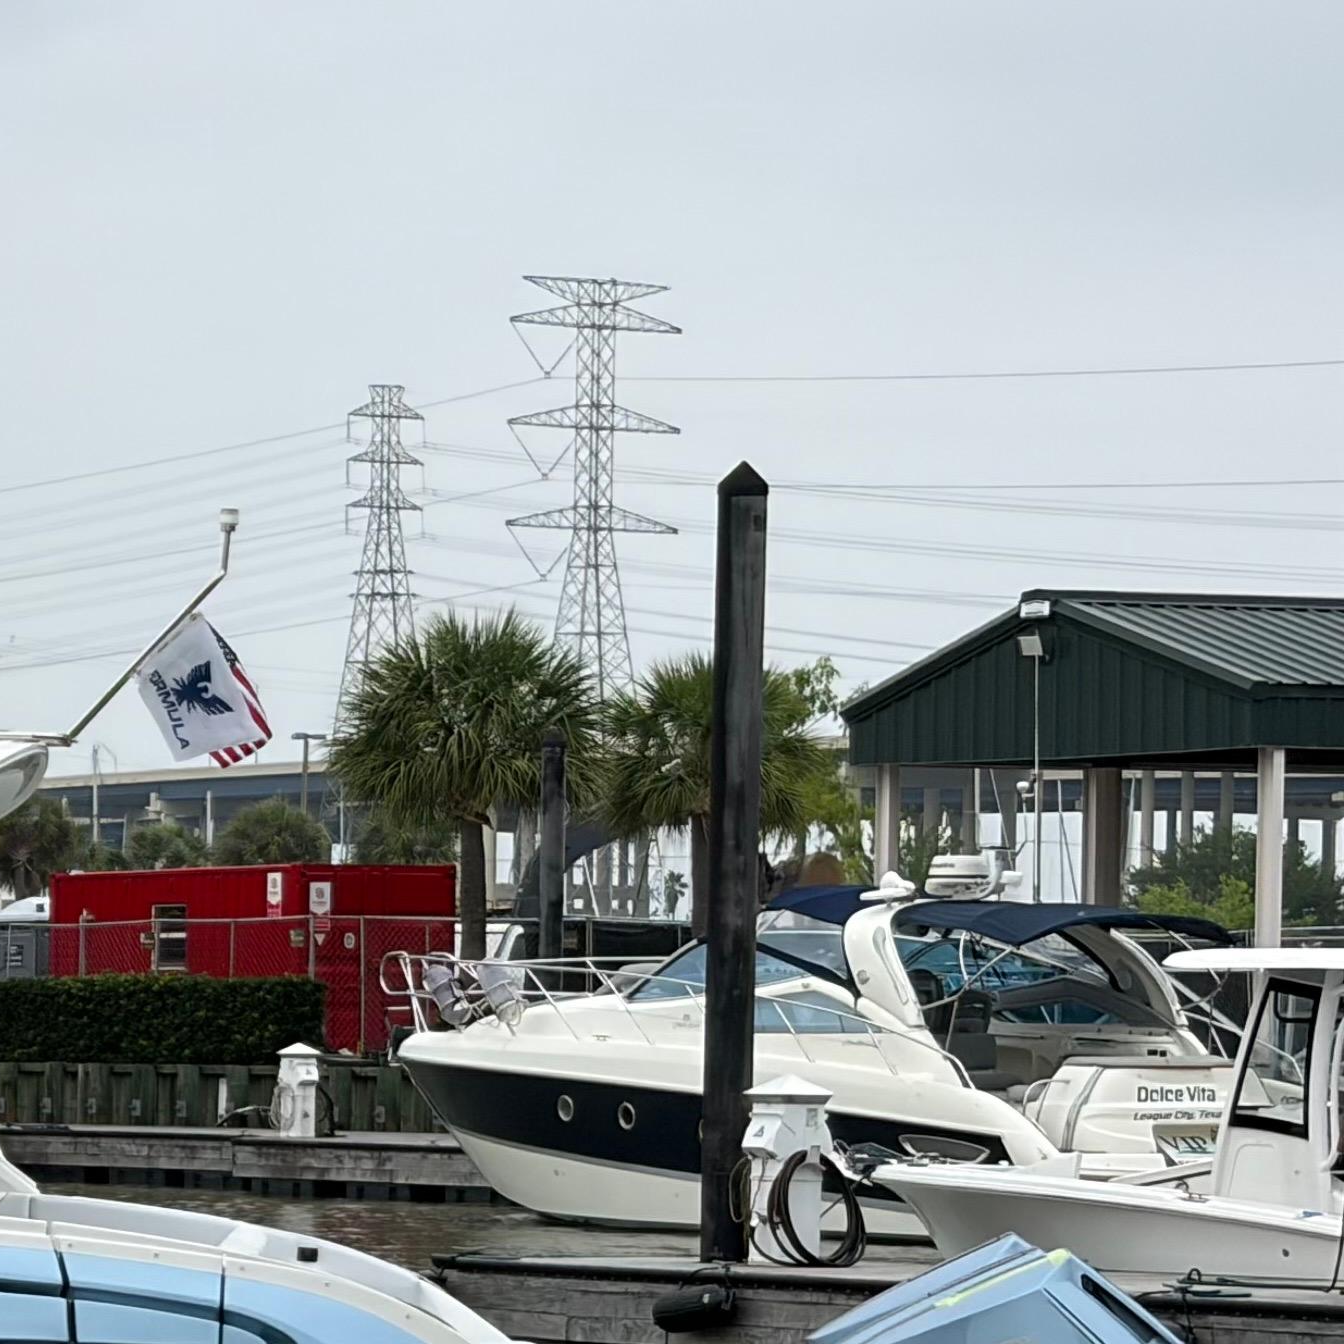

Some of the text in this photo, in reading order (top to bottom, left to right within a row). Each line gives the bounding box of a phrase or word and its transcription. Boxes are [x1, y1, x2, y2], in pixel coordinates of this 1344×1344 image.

[1137, 1086, 1216, 1102] Dolce Vita
[1133, 1111, 1173, 1121] League
[1198, 1109, 1223, 1119] Texa
